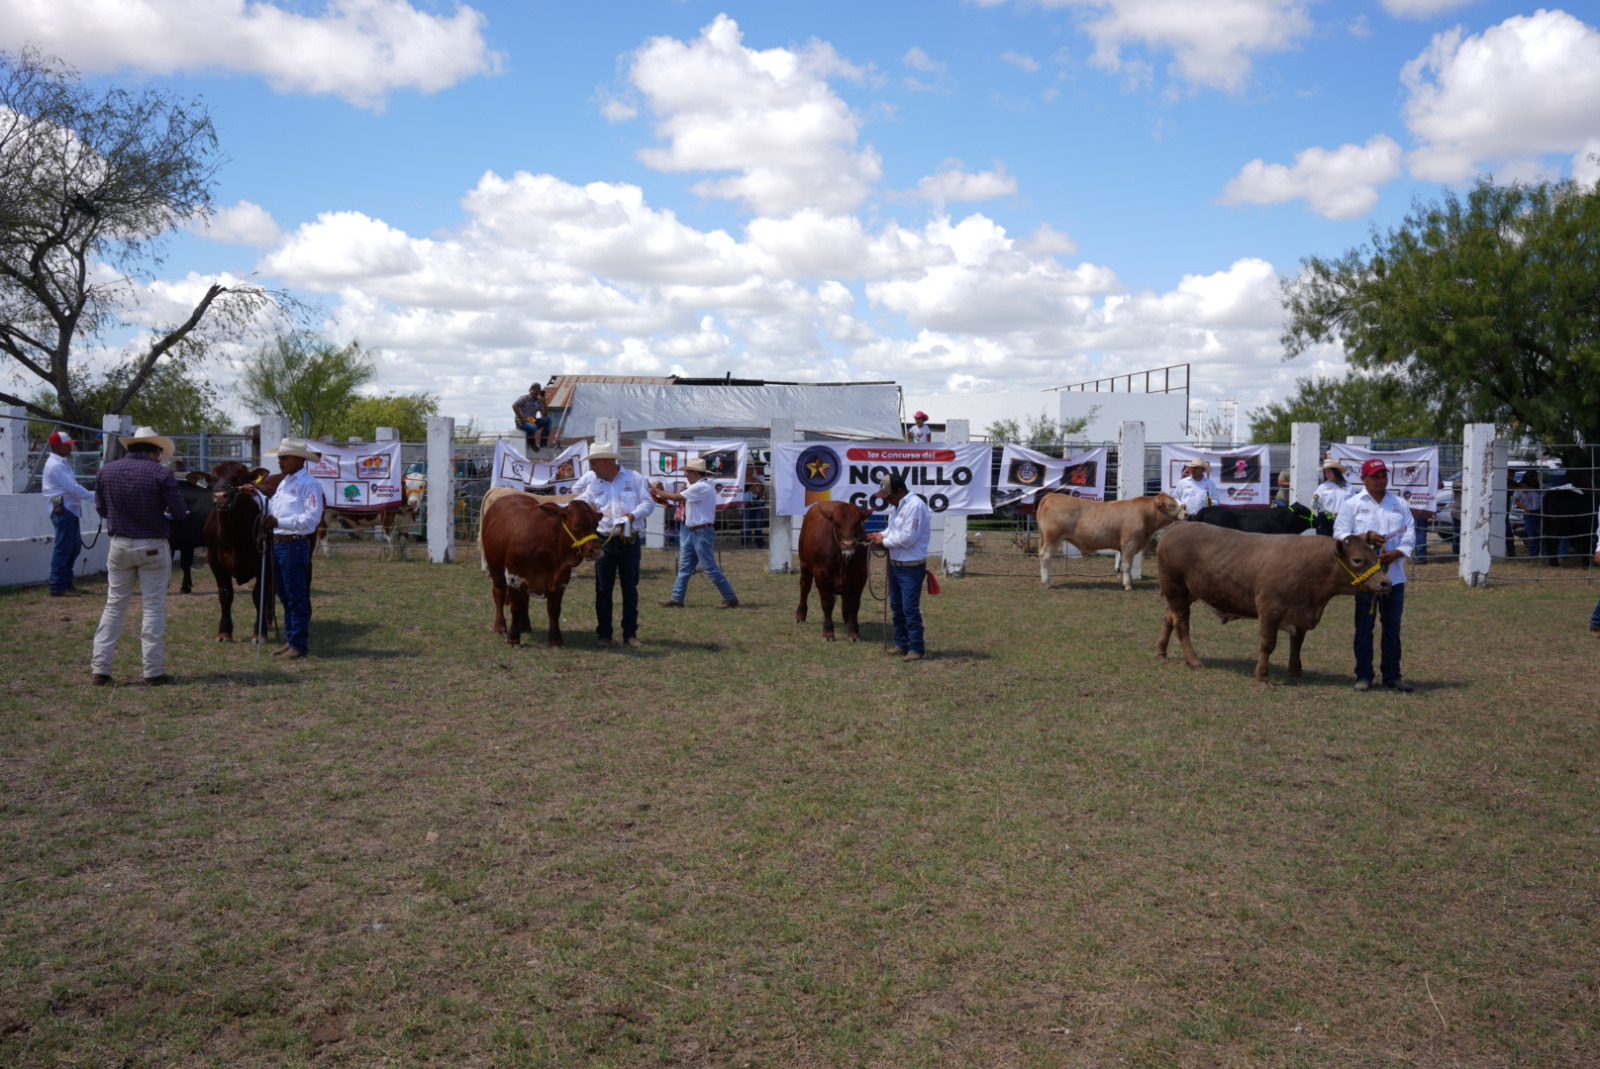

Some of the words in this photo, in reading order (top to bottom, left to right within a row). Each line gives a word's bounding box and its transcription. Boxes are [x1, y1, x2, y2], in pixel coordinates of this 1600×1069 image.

[867, 451, 879, 459] 1er
[881, 451, 921, 459] Concurso
[922, 451, 936, 459] del
[849, 465, 973, 486] NOVILLO
[849, 492, 950, 513] GOO
